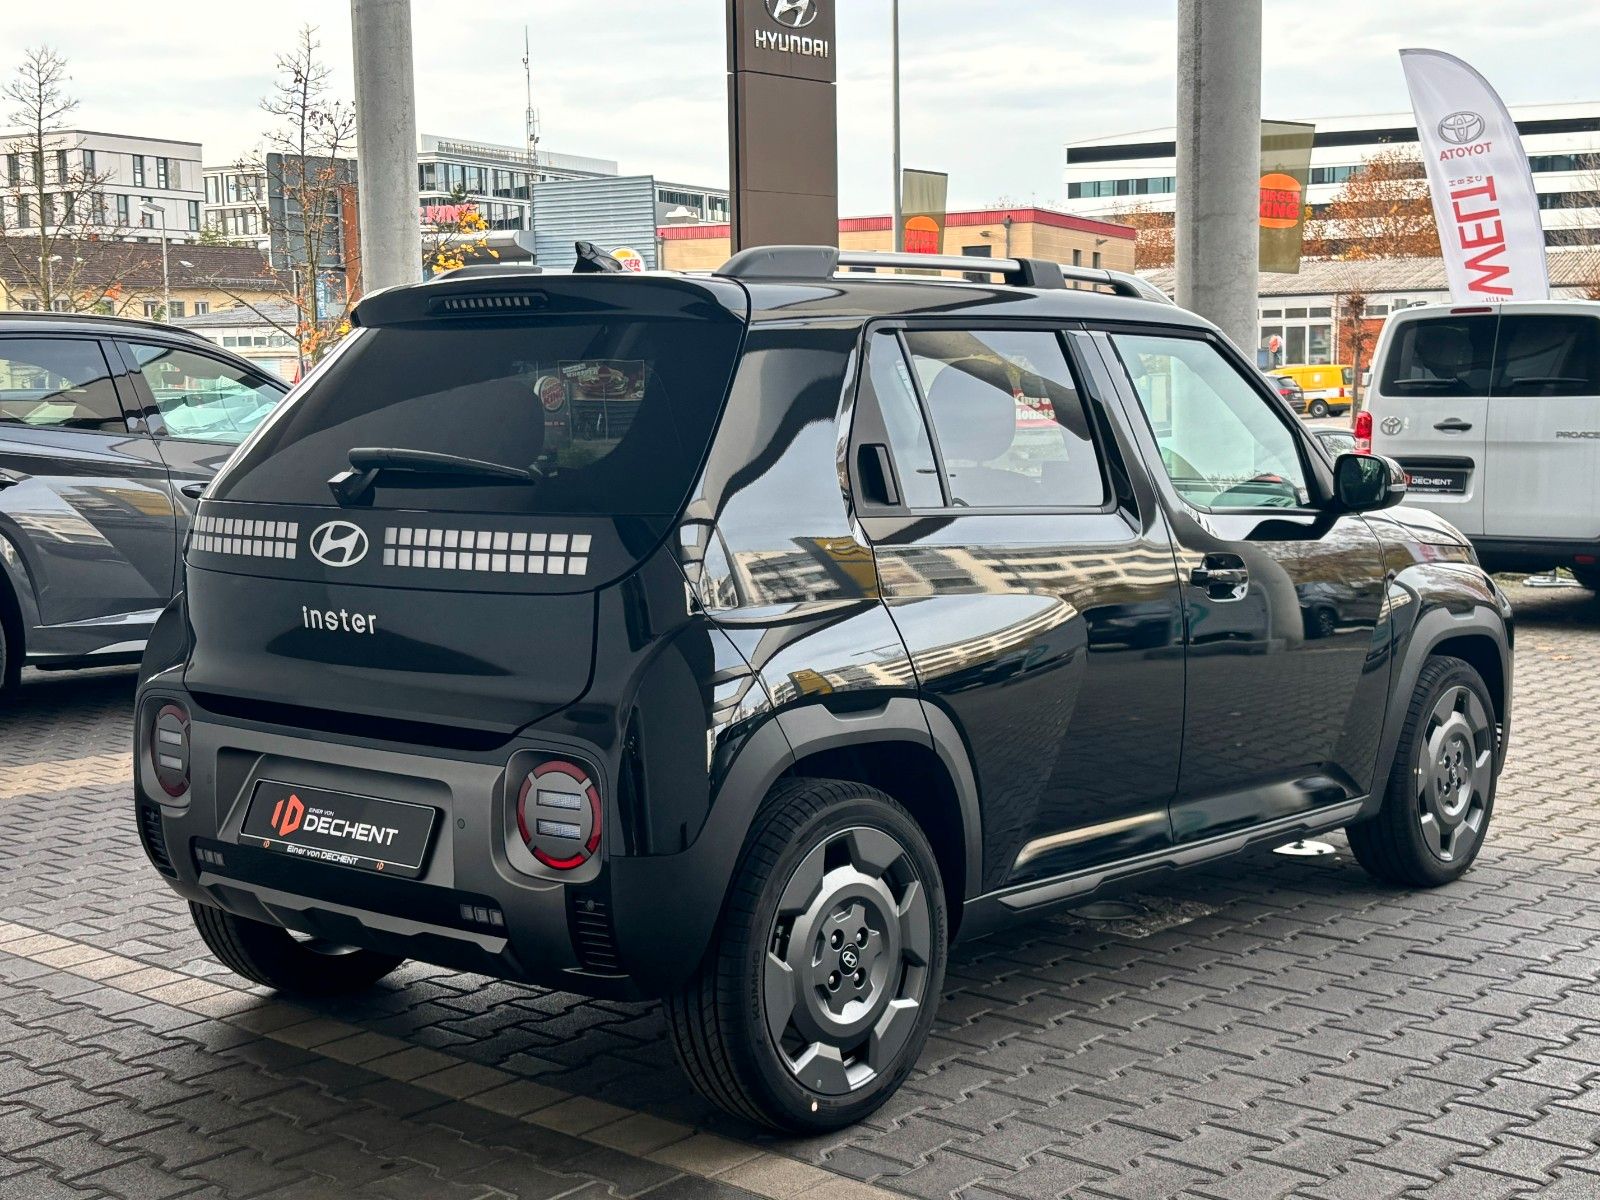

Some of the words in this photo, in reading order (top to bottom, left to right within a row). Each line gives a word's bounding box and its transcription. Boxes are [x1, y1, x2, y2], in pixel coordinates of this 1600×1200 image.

[755, 29, 829, 58] HYUNDAI
[1412, 478, 1452, 486] DECHENT
[302, 605, 377, 635] inster
[308, 807, 324, 815] EINER
[324, 809, 335, 817] VON
[303, 814, 399, 846] DECHENT
[287, 845, 306, 855] Einer
[306, 849, 320, 858] von
[320, 852, 358, 865] DECHENT
